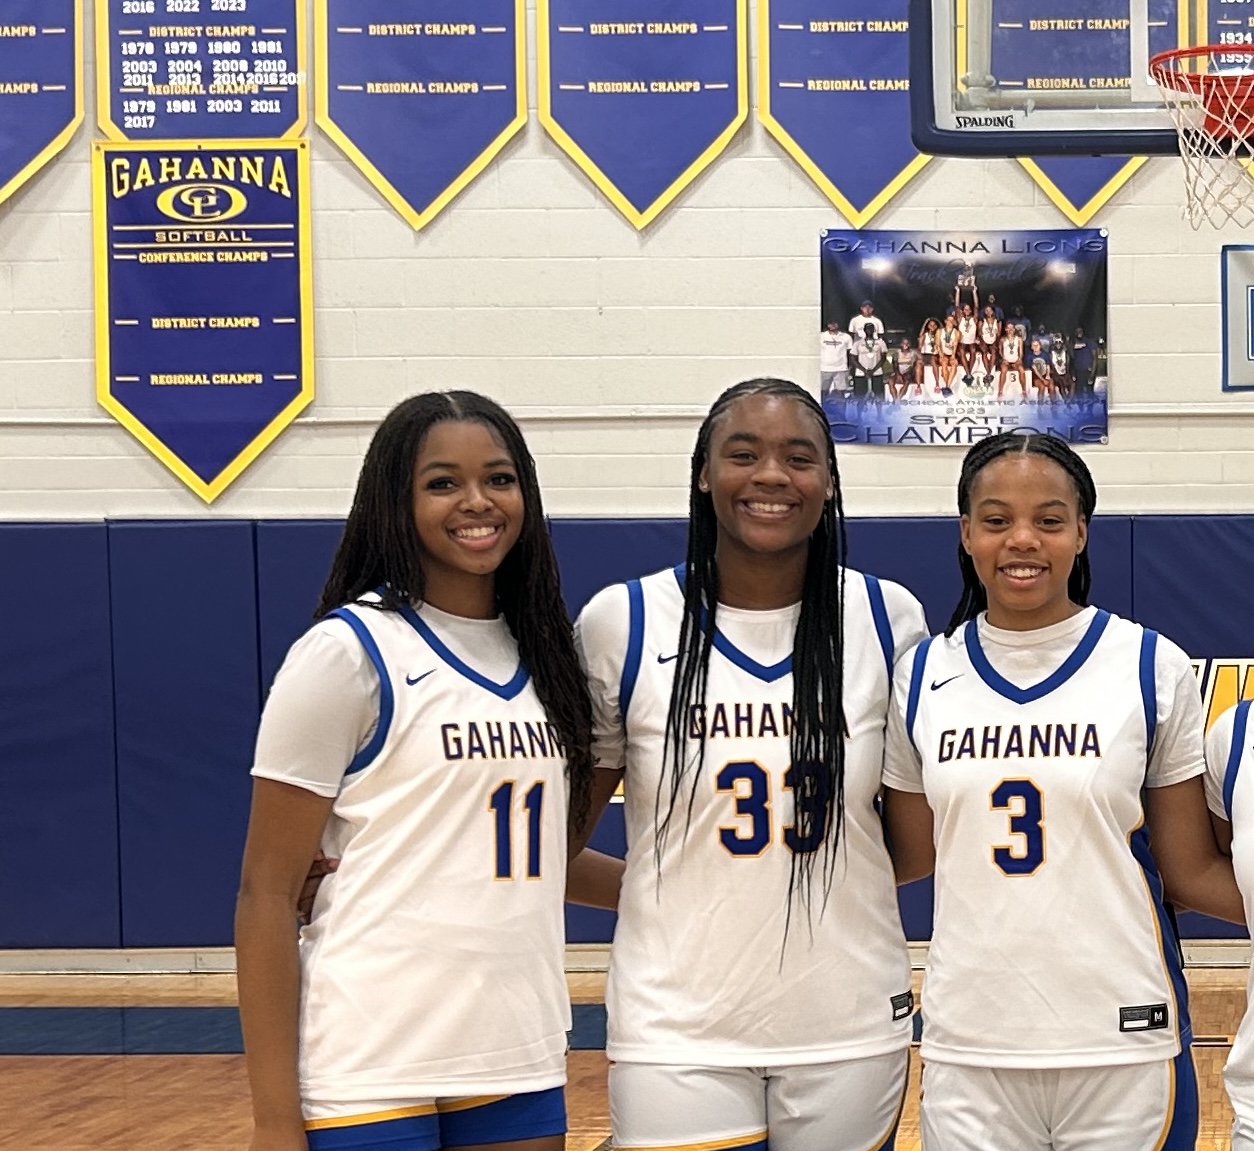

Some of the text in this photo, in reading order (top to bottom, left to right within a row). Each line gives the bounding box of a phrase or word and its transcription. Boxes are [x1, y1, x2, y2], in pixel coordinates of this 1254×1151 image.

[369, 24, 475, 35] DISTRICT CHAMPS
[590, 23, 697, 34] DISTRICT CHAMPS
[810, 21, 864, 32] DISTRICT
[1029, 19, 1083, 30] DISTRICT
[149, 26, 255, 37] DISTRICT CHAMPS
[1220, 32, 1252, 45] 1934
[168, 60, 287, 73] 2004 2010
[367, 82, 478, 93] REGIONAL CHAMPS
[589, 82, 700, 93] REGIONAL CHAMPS
[808, 80, 866, 91] REGIONAL
[1027, 78, 1086, 88] REGIONAL
[148, 84, 259, 95] REGIONAL CHAMPS
[251, 100, 280, 113] 2011
[124, 116, 155, 128] 2017
[956, 115, 1014, 128] SPALDING
[111, 156, 291, 198] GAHANNA
[156, 231, 253, 242] SOFTBALL
[823, 238, 1104, 254] GAHANNA LIONS
[139, 251, 268, 263] CONFERENCE CHAMPS
[152, 317, 260, 328] DISTRICT CHAMPS
[150, 374, 263, 385] REGIONAL CHAMPS
[910, 415, 1019, 425] STATE
[441, 721, 567, 760] GAHANN
[938, 723, 1103, 764] GAHANNA
[488, 779, 545, 881] 11
[989, 776, 1047, 878] 3
[1154, 1011, 1163, 1021] M
